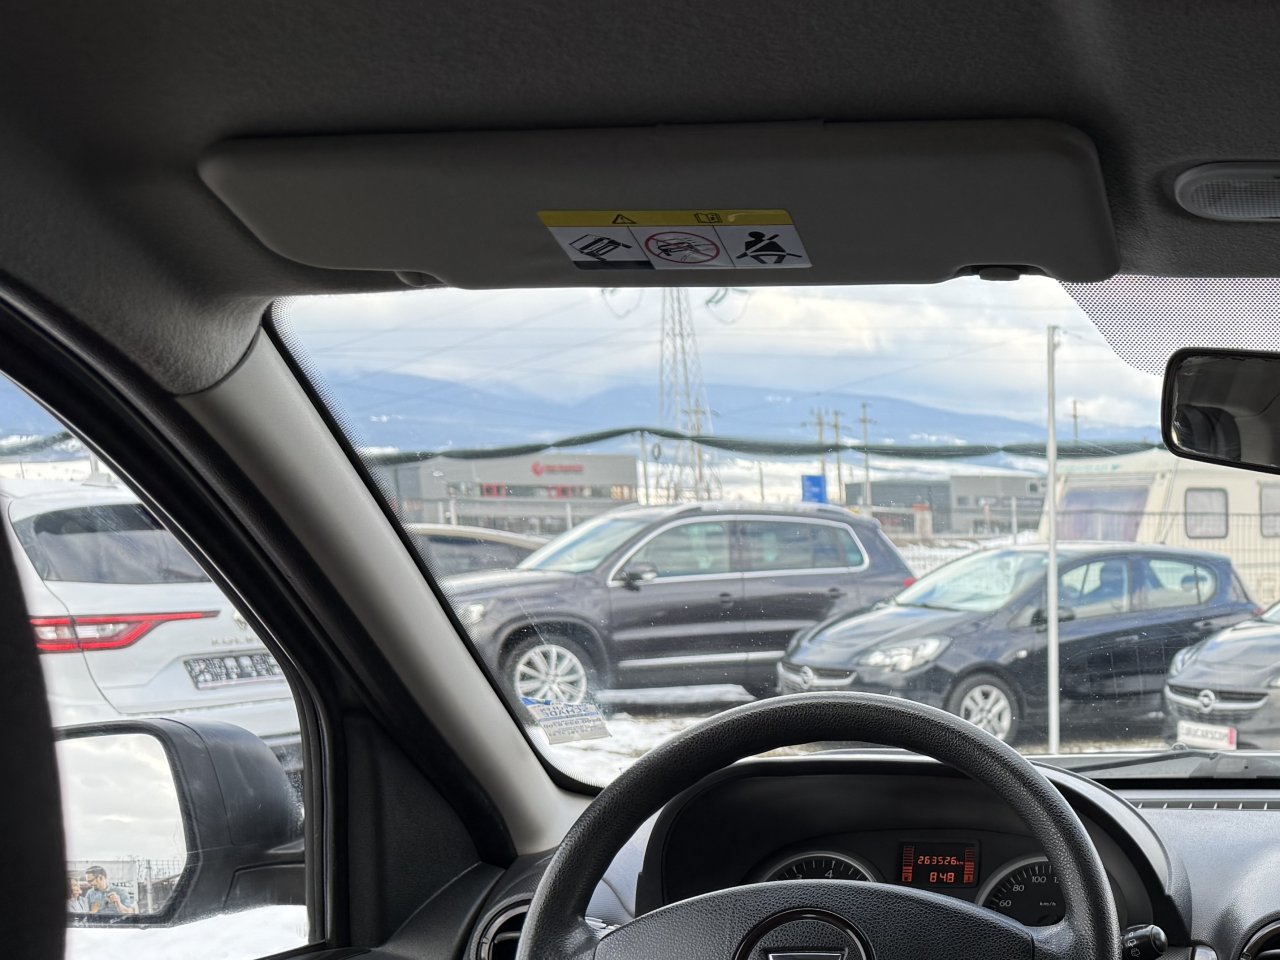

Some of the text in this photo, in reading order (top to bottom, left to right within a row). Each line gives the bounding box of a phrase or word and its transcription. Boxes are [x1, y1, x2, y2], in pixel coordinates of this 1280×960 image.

[917, 856, 957, 866] 263526
[825, 869, 833, 879] 4
[929, 872, 955, 883] 848
[999, 899, 1012, 907] 60
[1012, 884, 1025, 892] 80
